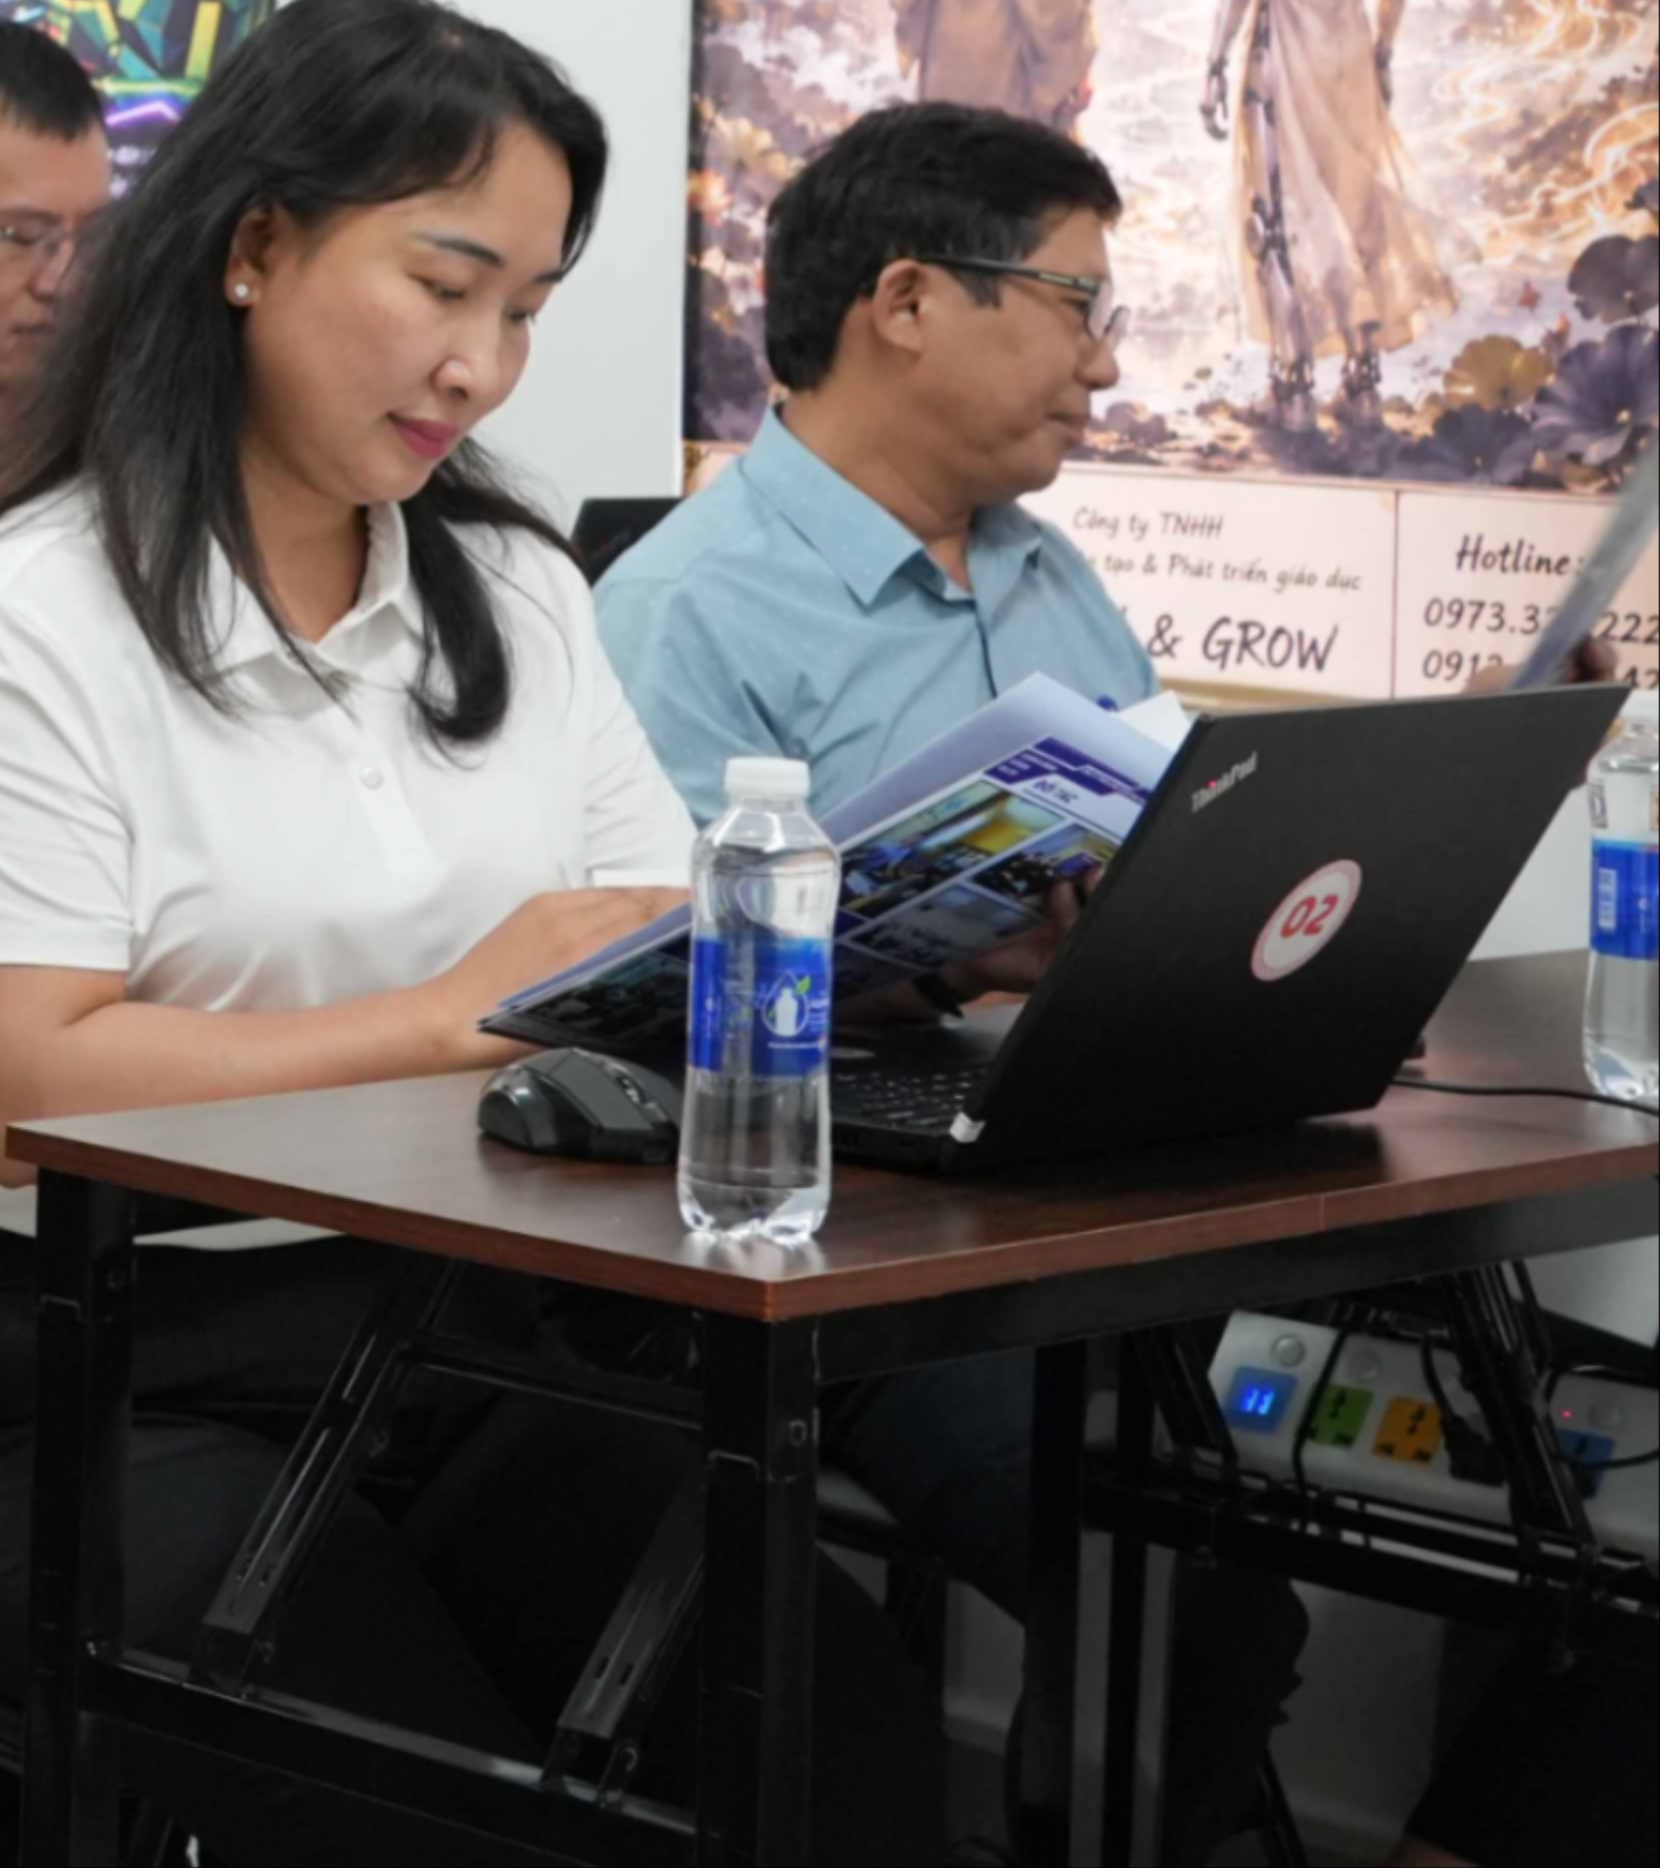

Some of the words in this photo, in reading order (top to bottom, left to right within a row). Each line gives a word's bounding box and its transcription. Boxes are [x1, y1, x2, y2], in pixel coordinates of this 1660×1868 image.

[1072, 506, 1120, 537] Công
[1127, 515, 1150, 540] ty
[1160, 512, 1225, 538] TNHH
[1104, 550, 1135, 577] tạo
[1141, 551, 1158, 575] &
[1167, 555, 1216, 581] Phát
[1218, 551, 1269, 585] triển
[1274, 562, 1319, 593] giáo
[1324, 566, 1363, 593] dục
[1146, 615, 1184, 659] &
[1201, 616, 1340, 673] GROW
[1190, 751, 1259, 814] ThinkPad
[1278, 891, 1340, 937] 02
